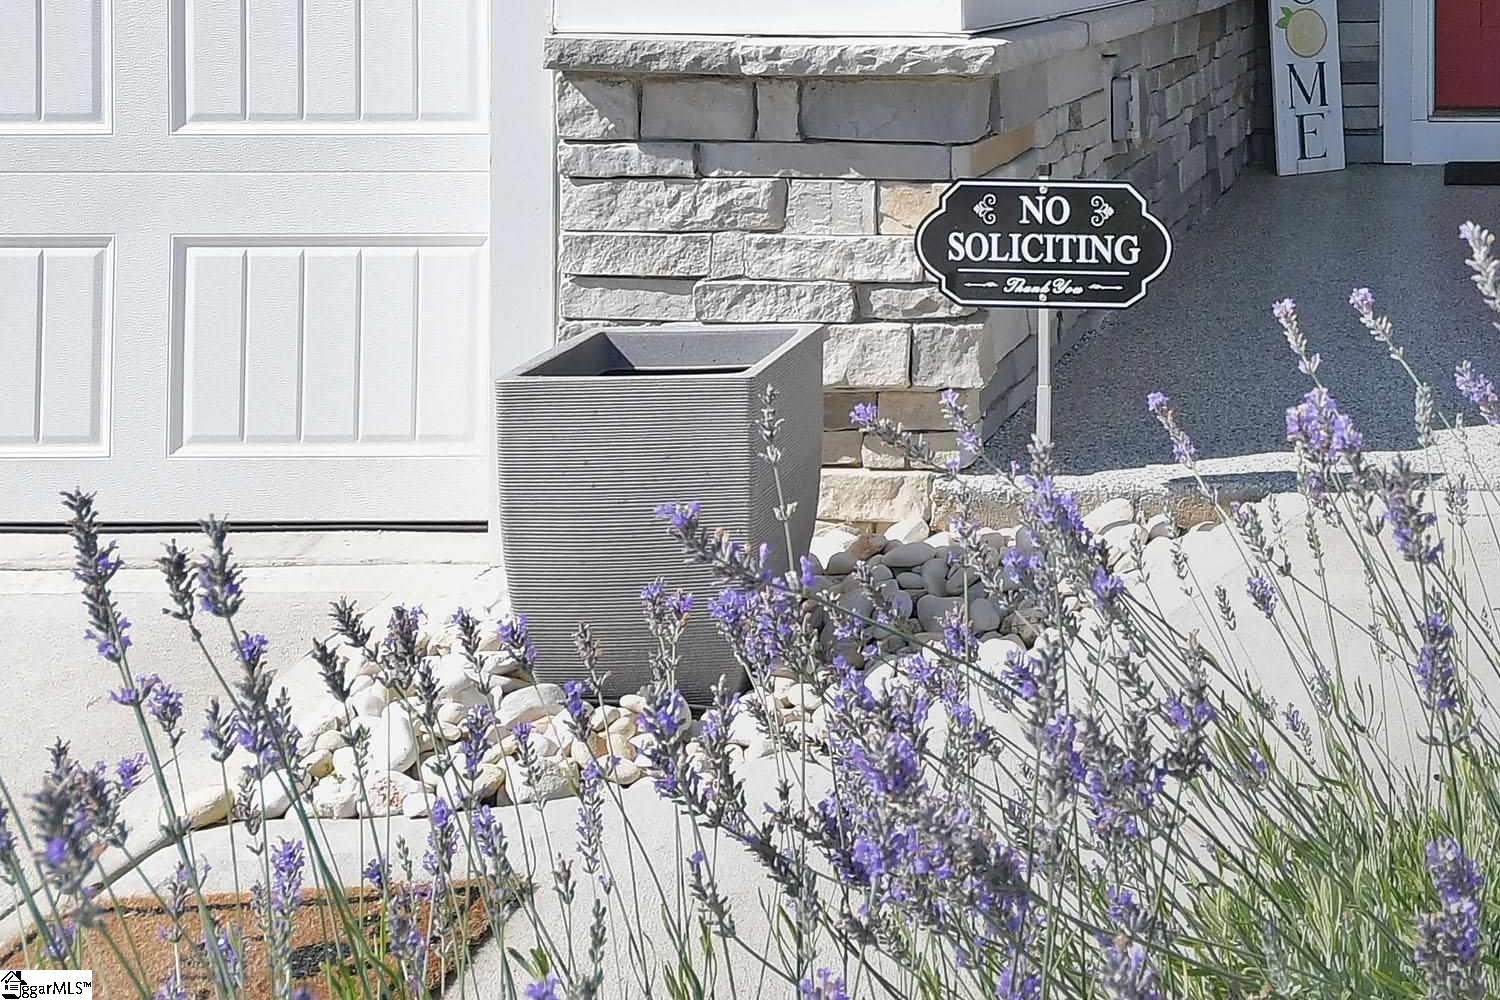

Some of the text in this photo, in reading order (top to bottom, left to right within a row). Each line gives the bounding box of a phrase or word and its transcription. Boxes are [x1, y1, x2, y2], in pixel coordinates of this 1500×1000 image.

[1019, 195, 1071, 225] NO
[948, 231, 1142, 265] SOLICITING
[1003, 276, 1084, 295] Thank You
